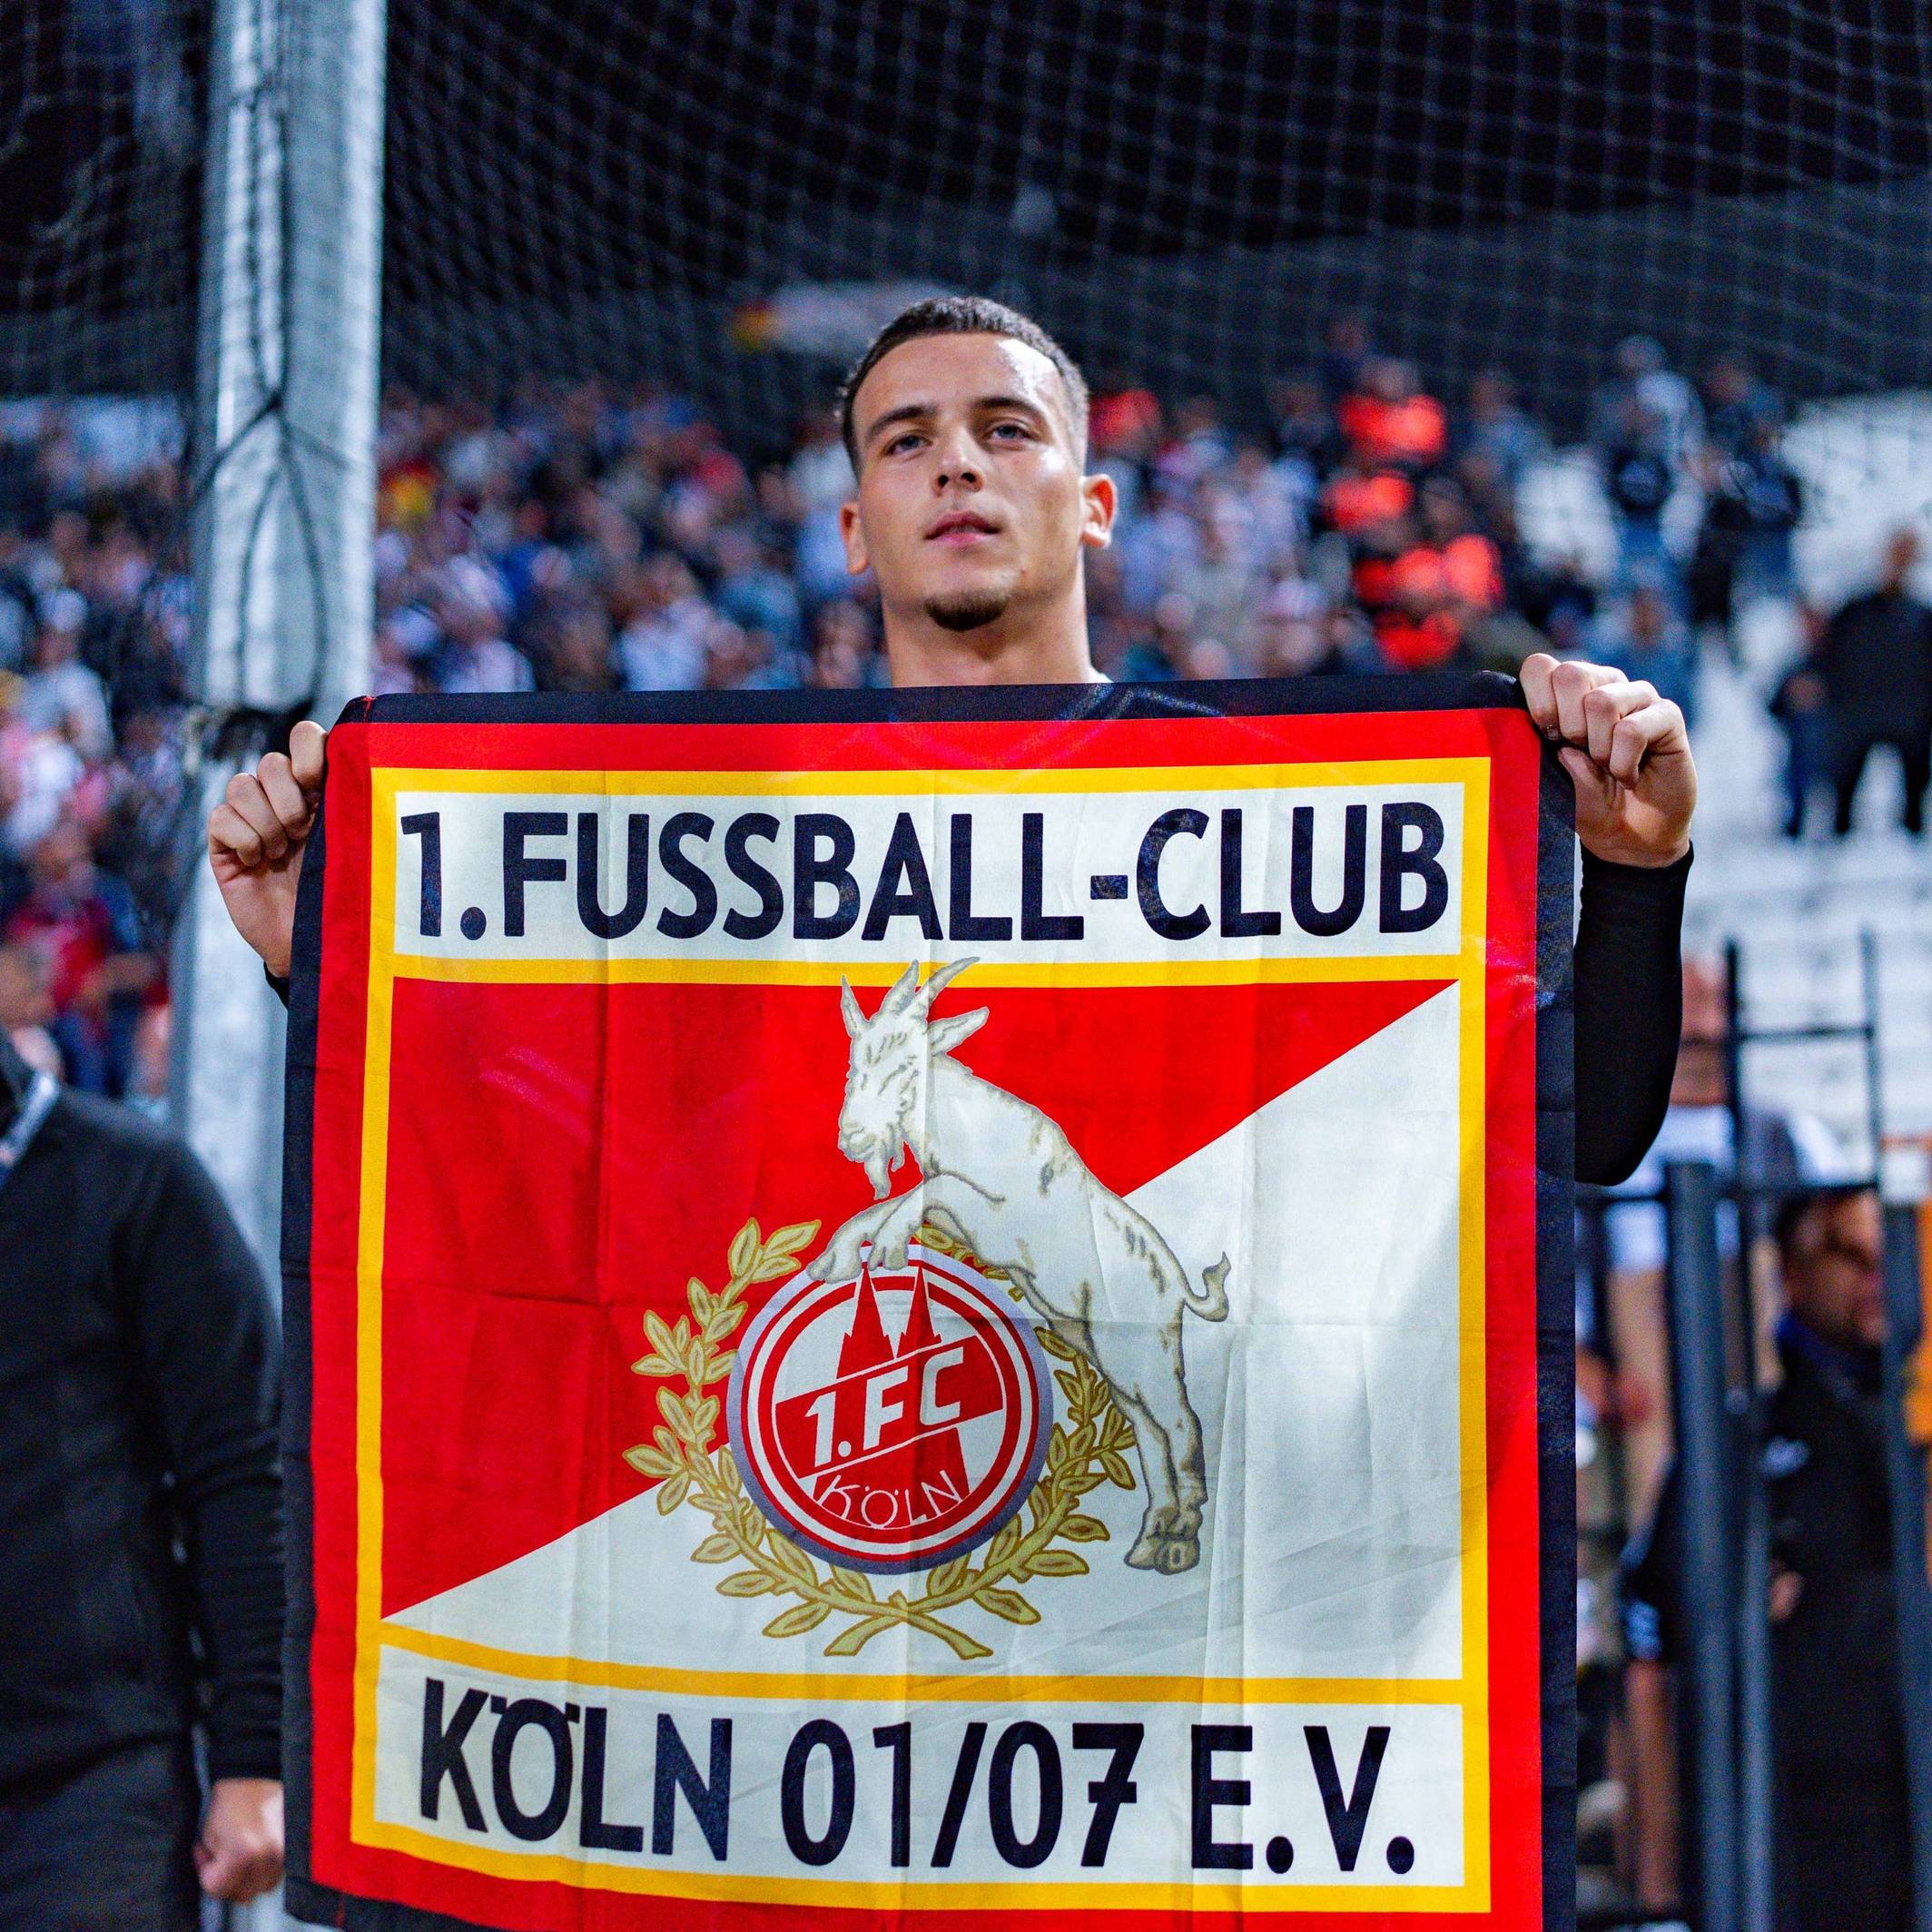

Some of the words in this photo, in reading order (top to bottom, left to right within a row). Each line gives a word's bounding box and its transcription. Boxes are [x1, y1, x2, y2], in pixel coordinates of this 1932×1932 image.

[816, 1469, 964, 1529] KÖLN
[419, 1677, 733, 1861] KÖLN
[781, 1719, 1145, 1868] 01/07
[1190, 1723, 1414, 1875] E.V.
